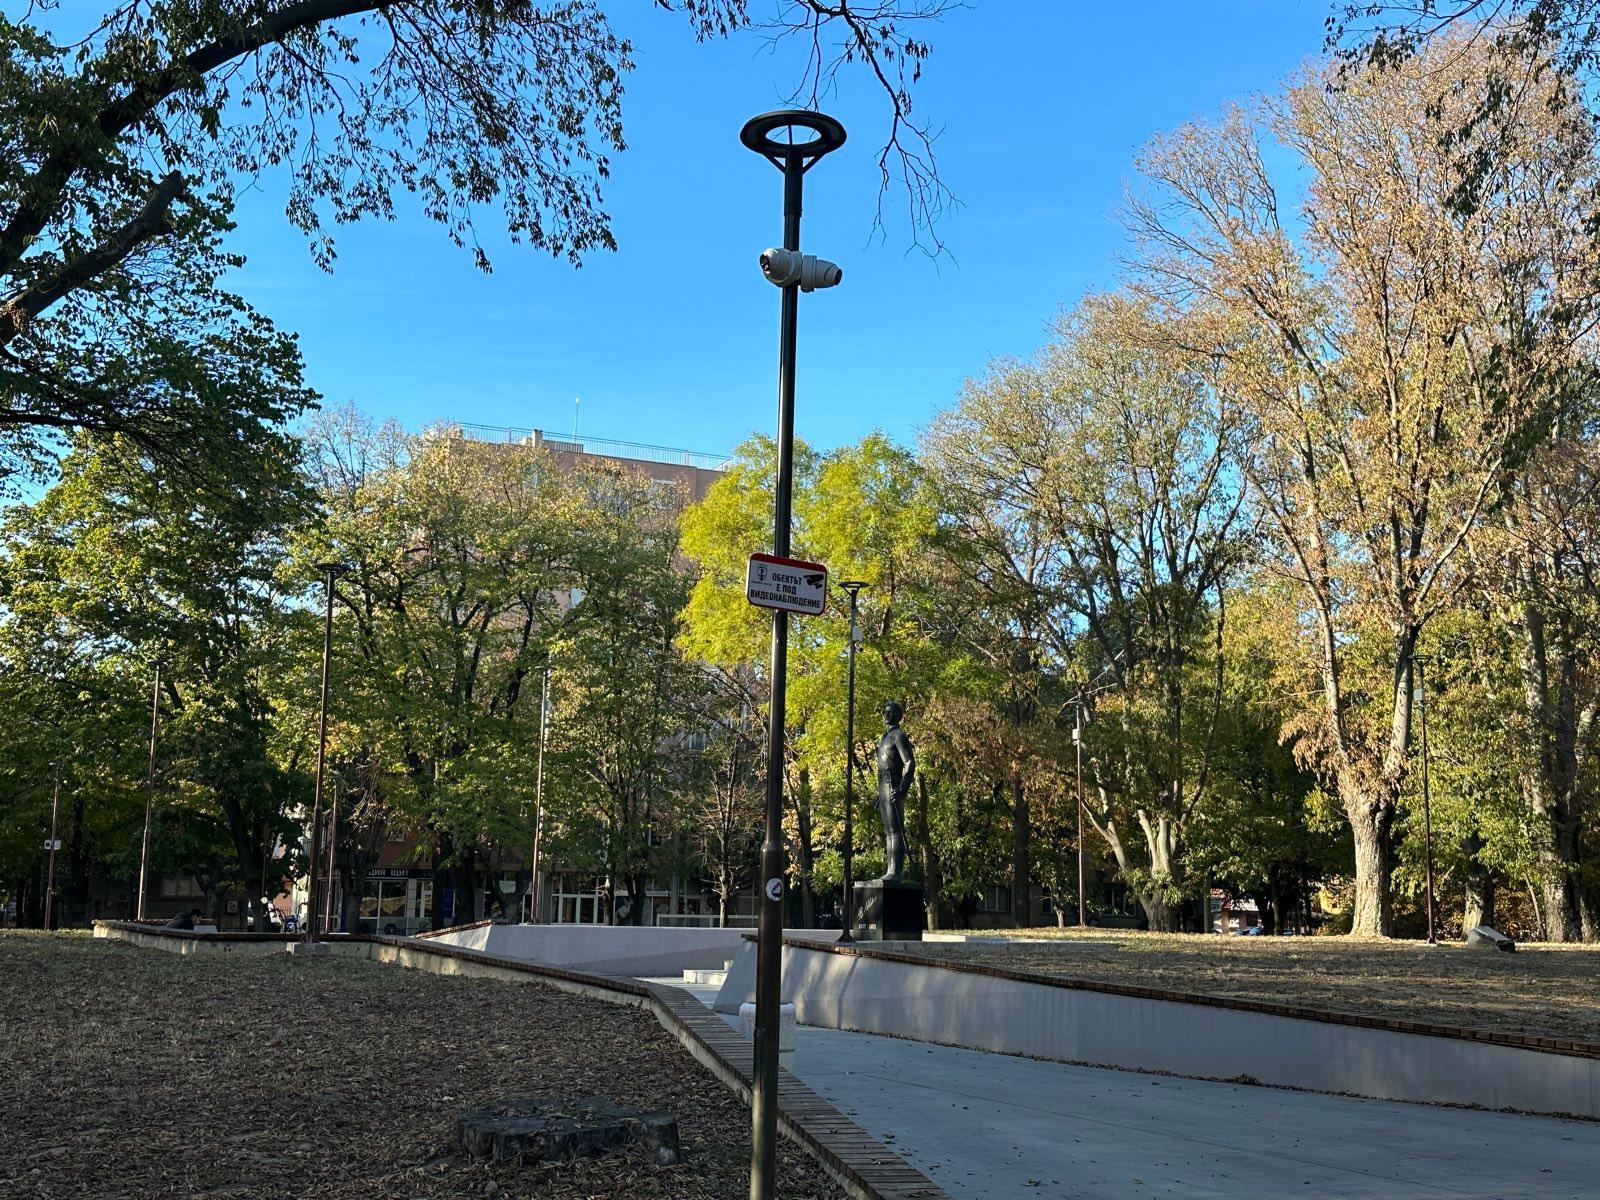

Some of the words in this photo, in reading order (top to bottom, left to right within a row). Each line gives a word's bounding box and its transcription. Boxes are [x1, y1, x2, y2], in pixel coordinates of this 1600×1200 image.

[772, 572, 803, 586] ОБЕКТЪТ
[776, 584, 781, 592] Е
[782, 584, 797, 596] ПОД
[750, 589, 821, 609] ВИДЕОНАБЛЮДЕНИЕ
[390, 868, 409, 877] ЩИТ
